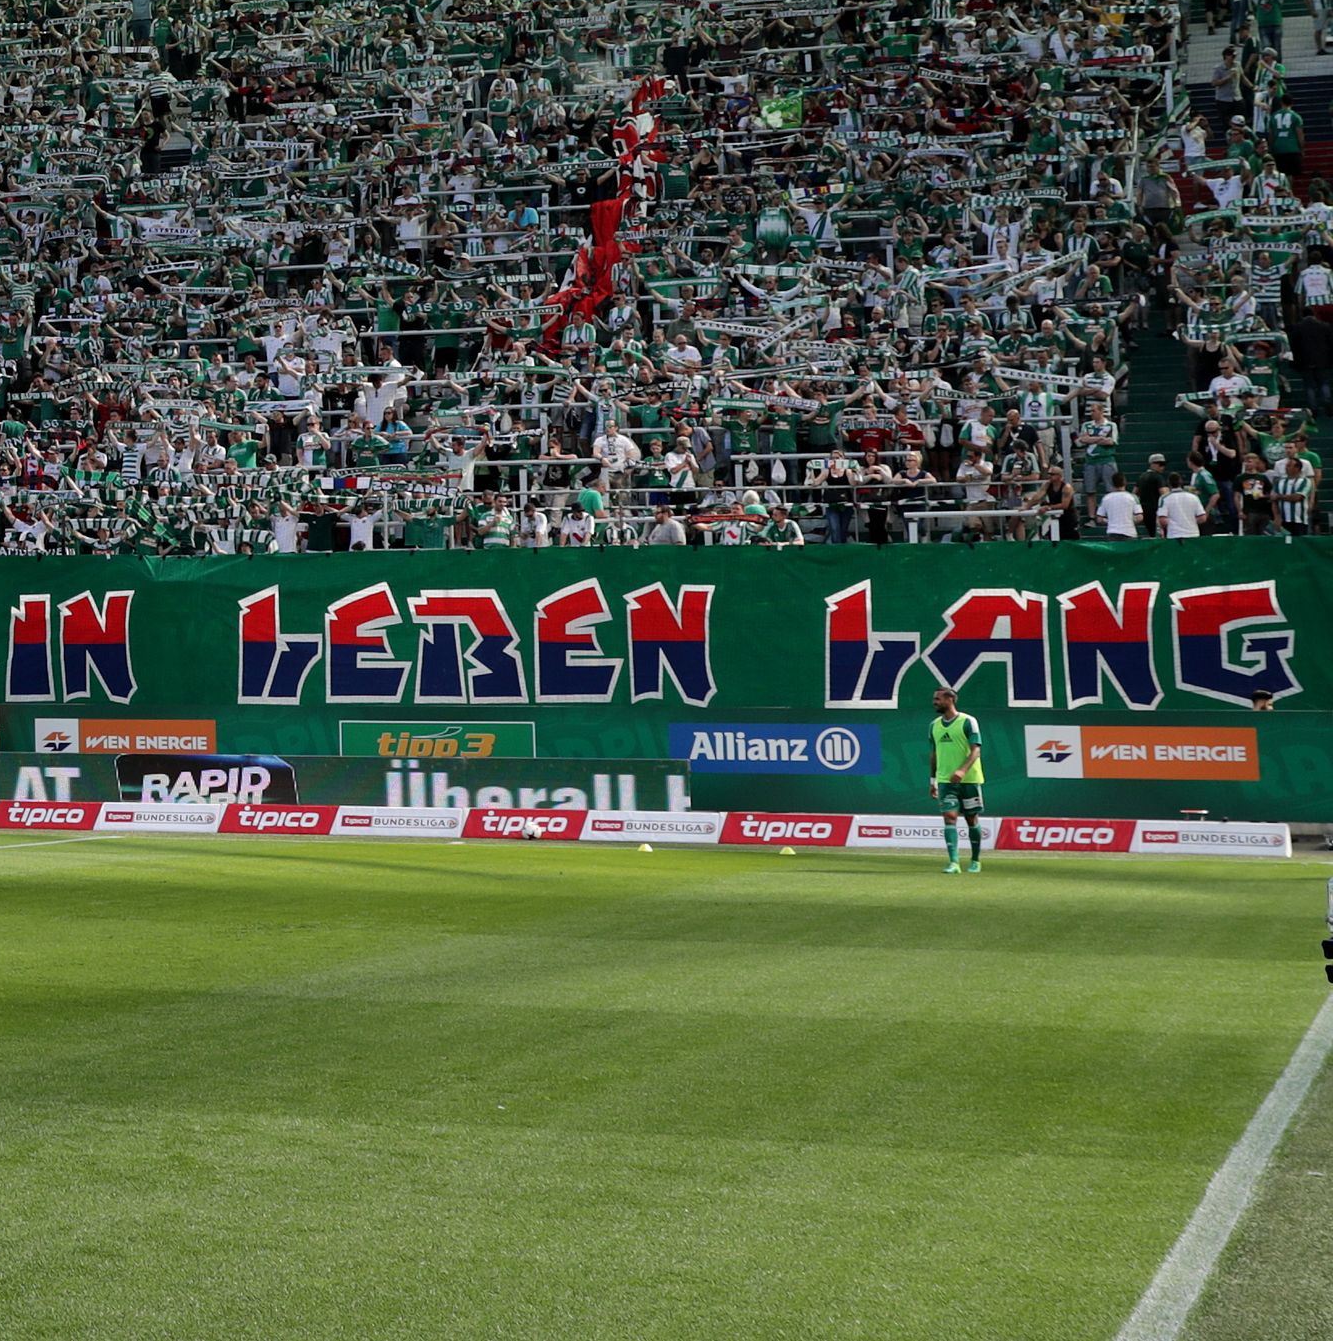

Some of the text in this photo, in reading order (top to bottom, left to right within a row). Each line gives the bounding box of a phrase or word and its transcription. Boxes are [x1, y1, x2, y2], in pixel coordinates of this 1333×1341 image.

[1274, 113, 1292, 129] 14
[999, 369, 1079, 385] WESTSTADION
[238, 577, 718, 707] LEBEN
[824, 578, 1304, 710] LANG
[85, 735, 208, 751] WIEN ENERGIE
[690, 731, 809, 762] Allianz
[1090, 744, 1247, 762] WIEN ENERGIE
[8, 802, 84, 826] tipico
[135, 813, 204, 823] BUNDESLIGA
[238, 806, 320, 830] tipico
[373, 818, 446, 828] BUNDESLIGA
[626, 822, 702, 833] BUNDESLIGA
[740, 814, 833, 842] tipico
[1016, 821, 1115, 847] tipico
[1144, 832, 1269, 845] tipico BUNDESLIGA
